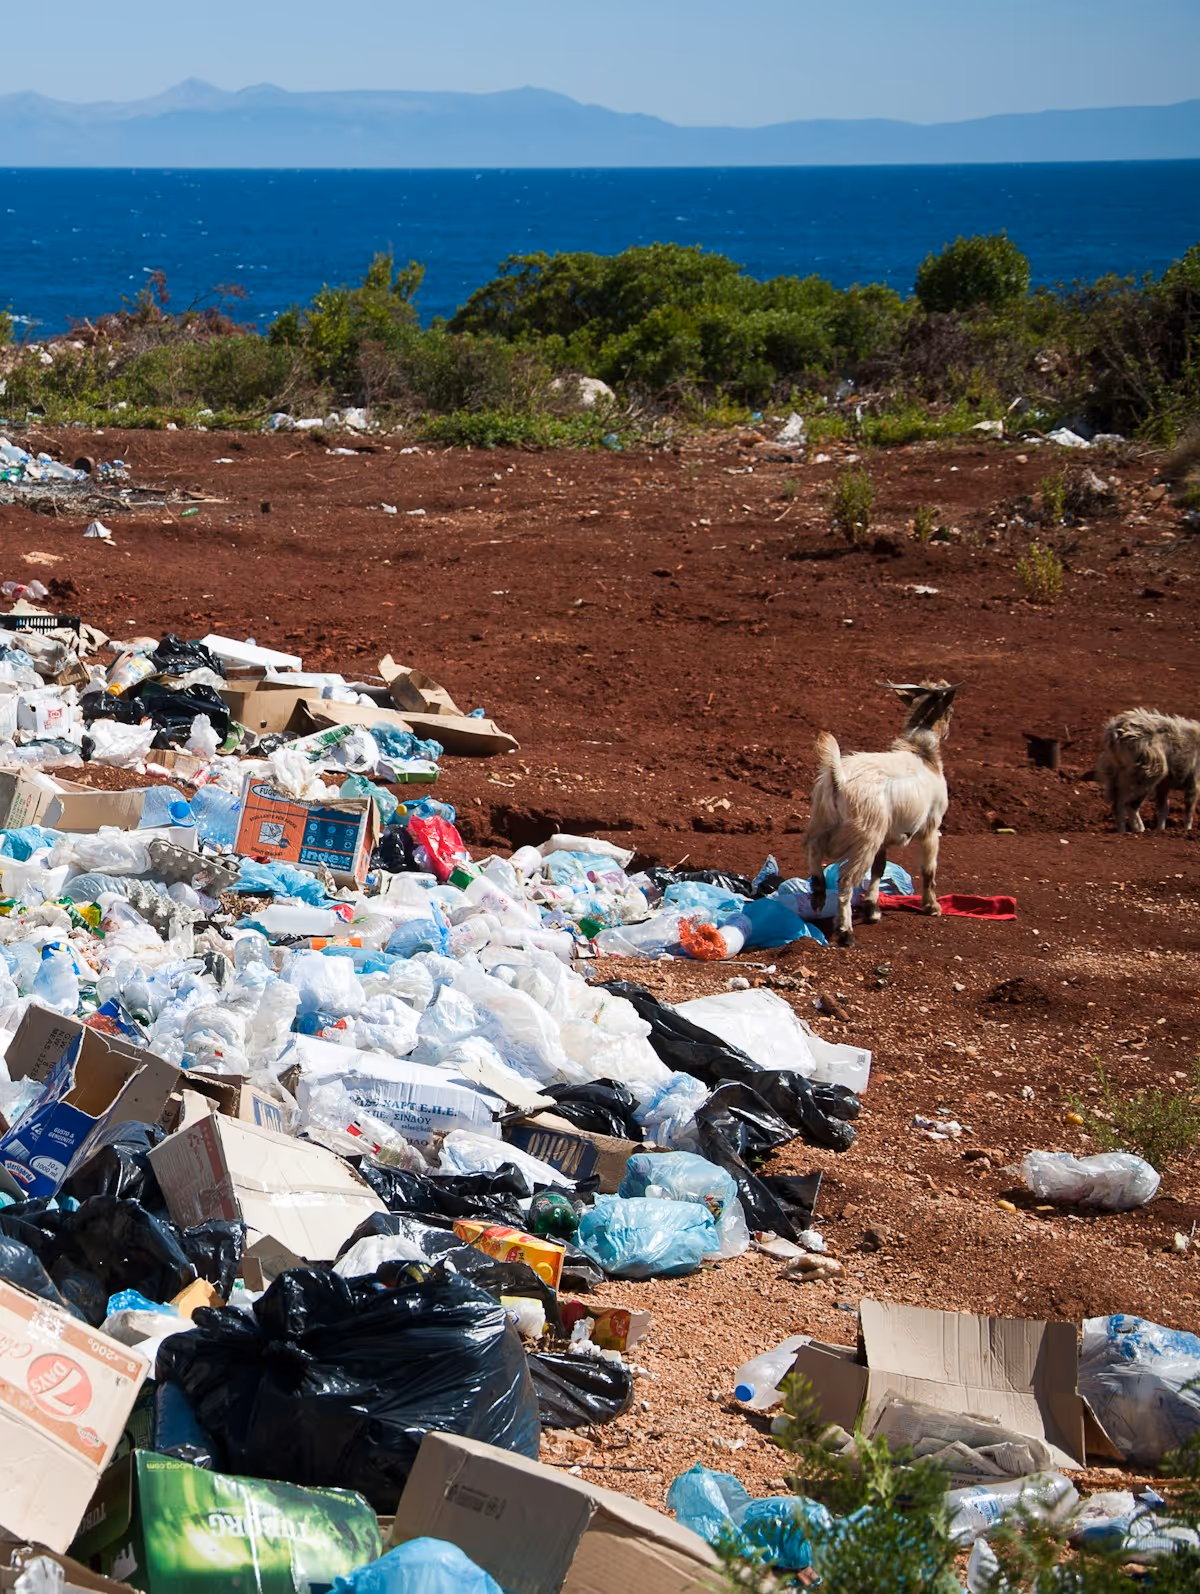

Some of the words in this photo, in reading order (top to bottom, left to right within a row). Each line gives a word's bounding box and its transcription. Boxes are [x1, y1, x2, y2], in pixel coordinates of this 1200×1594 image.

[53, 1127, 69, 1137] GUSTO
[35, 1162, 52, 1174] 1000
[30, 1361, 69, 1393] DAYS
[41, 1367, 82, 1415] 7
